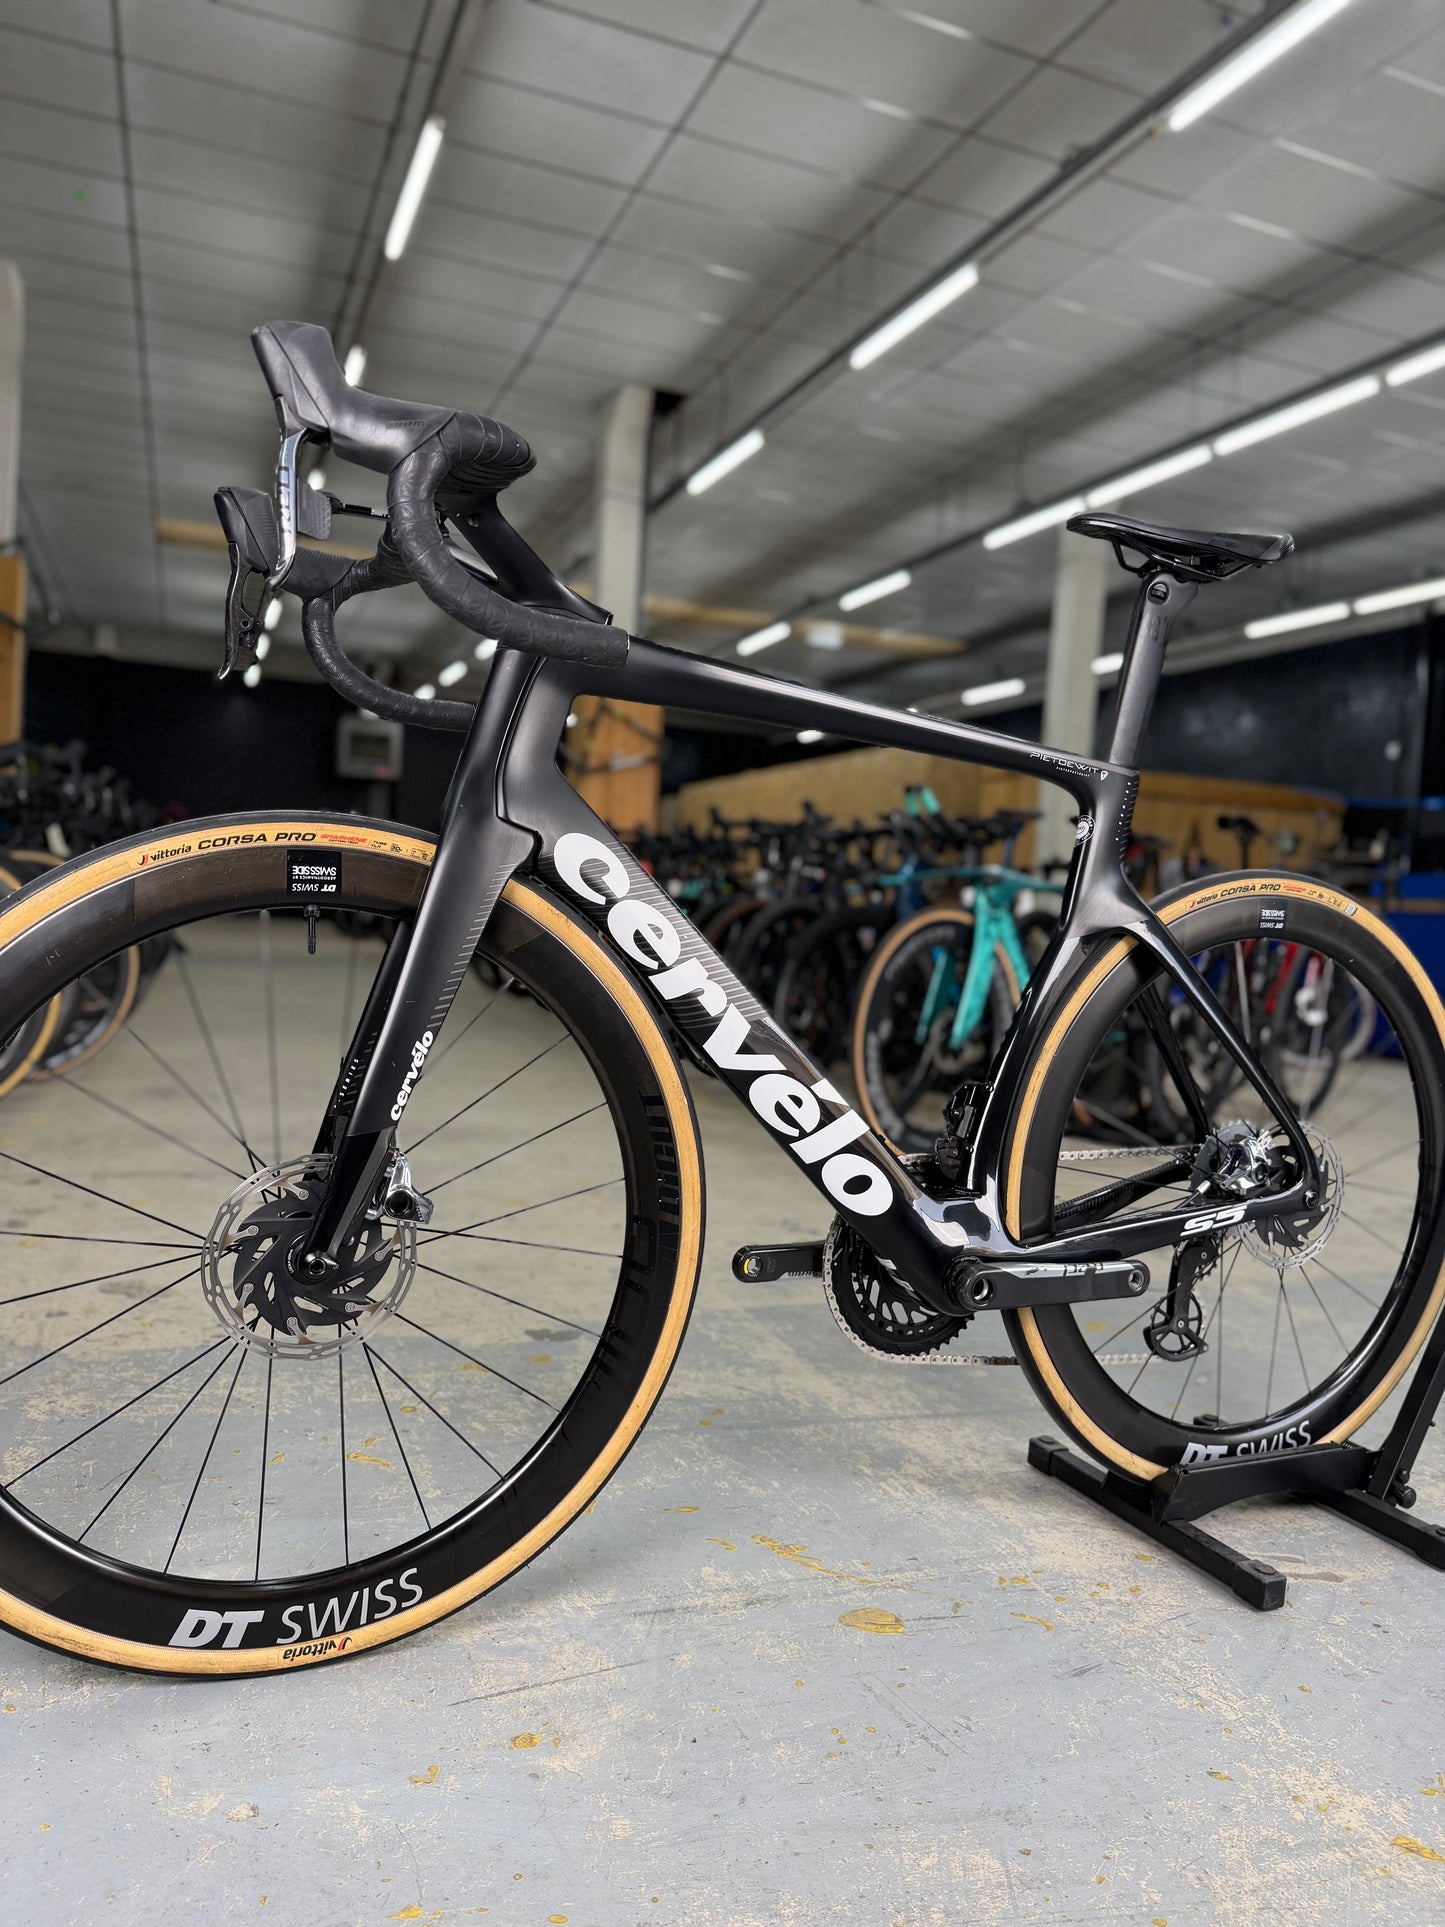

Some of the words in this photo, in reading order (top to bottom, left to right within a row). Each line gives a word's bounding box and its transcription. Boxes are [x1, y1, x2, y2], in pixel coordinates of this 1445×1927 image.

[150, 843, 192, 862] vittoria
[197, 832, 267, 851] CORSA
[274, 832, 316, 843] PRO
[292, 883, 320, 892] SWISS
[320, 884, 337, 892] DT
[1220, 884, 1256, 898] CORSA
[1180, 1204, 1248, 1237] S5
[167, 1608, 265, 1649] DT
[275, 1567, 423, 1645] SWISS
[282, 1639, 337, 1662] vittoria
